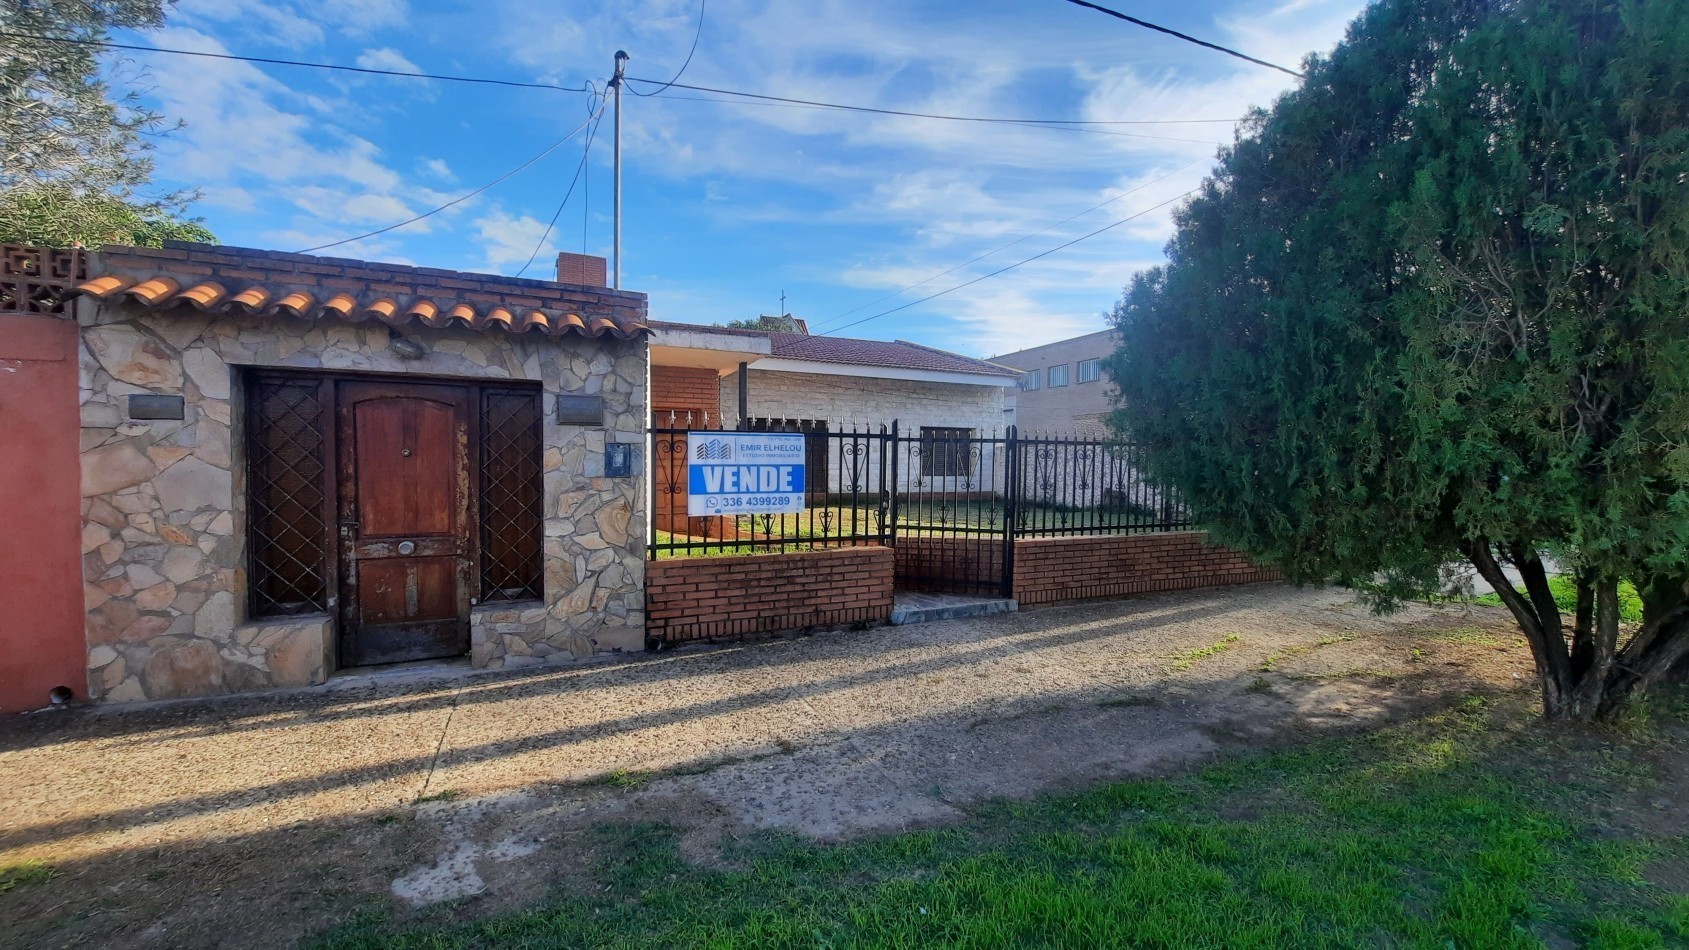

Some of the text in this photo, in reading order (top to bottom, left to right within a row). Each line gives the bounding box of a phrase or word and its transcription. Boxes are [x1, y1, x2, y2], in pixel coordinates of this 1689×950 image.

[740, 444, 761, 452] EMIR
[702, 466, 793, 493] VENDE
[723, 496, 790, 507] 336 4399289
